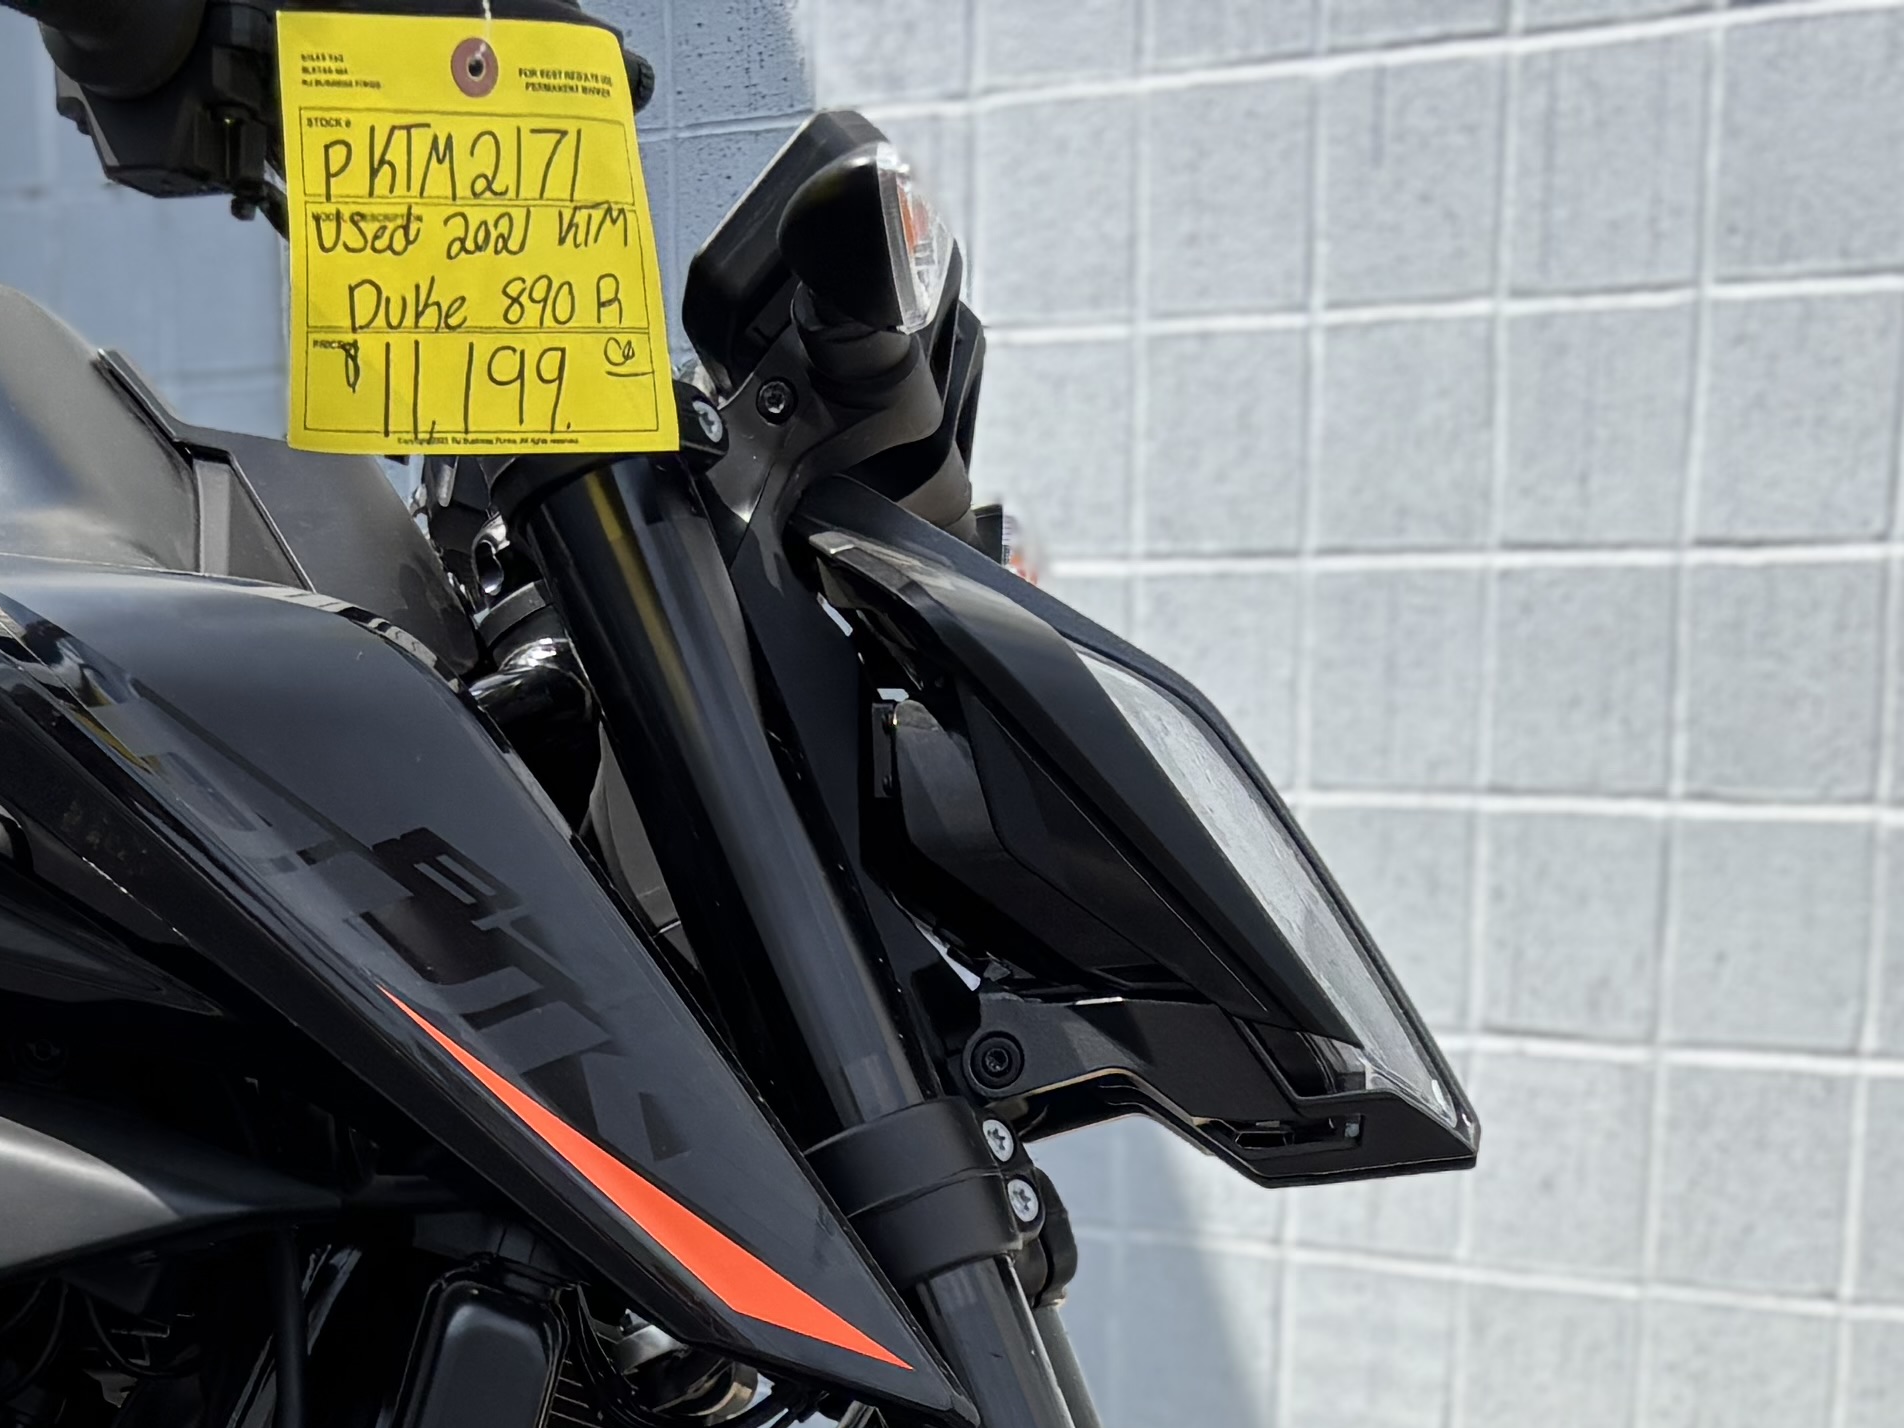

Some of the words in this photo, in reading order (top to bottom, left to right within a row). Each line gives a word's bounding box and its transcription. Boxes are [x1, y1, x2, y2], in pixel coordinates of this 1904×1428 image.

[444, 207, 531, 260] 2021
[558, 200, 628, 249] KTM
[501, 273, 576, 327] 890
[595, 273, 623, 326] R
